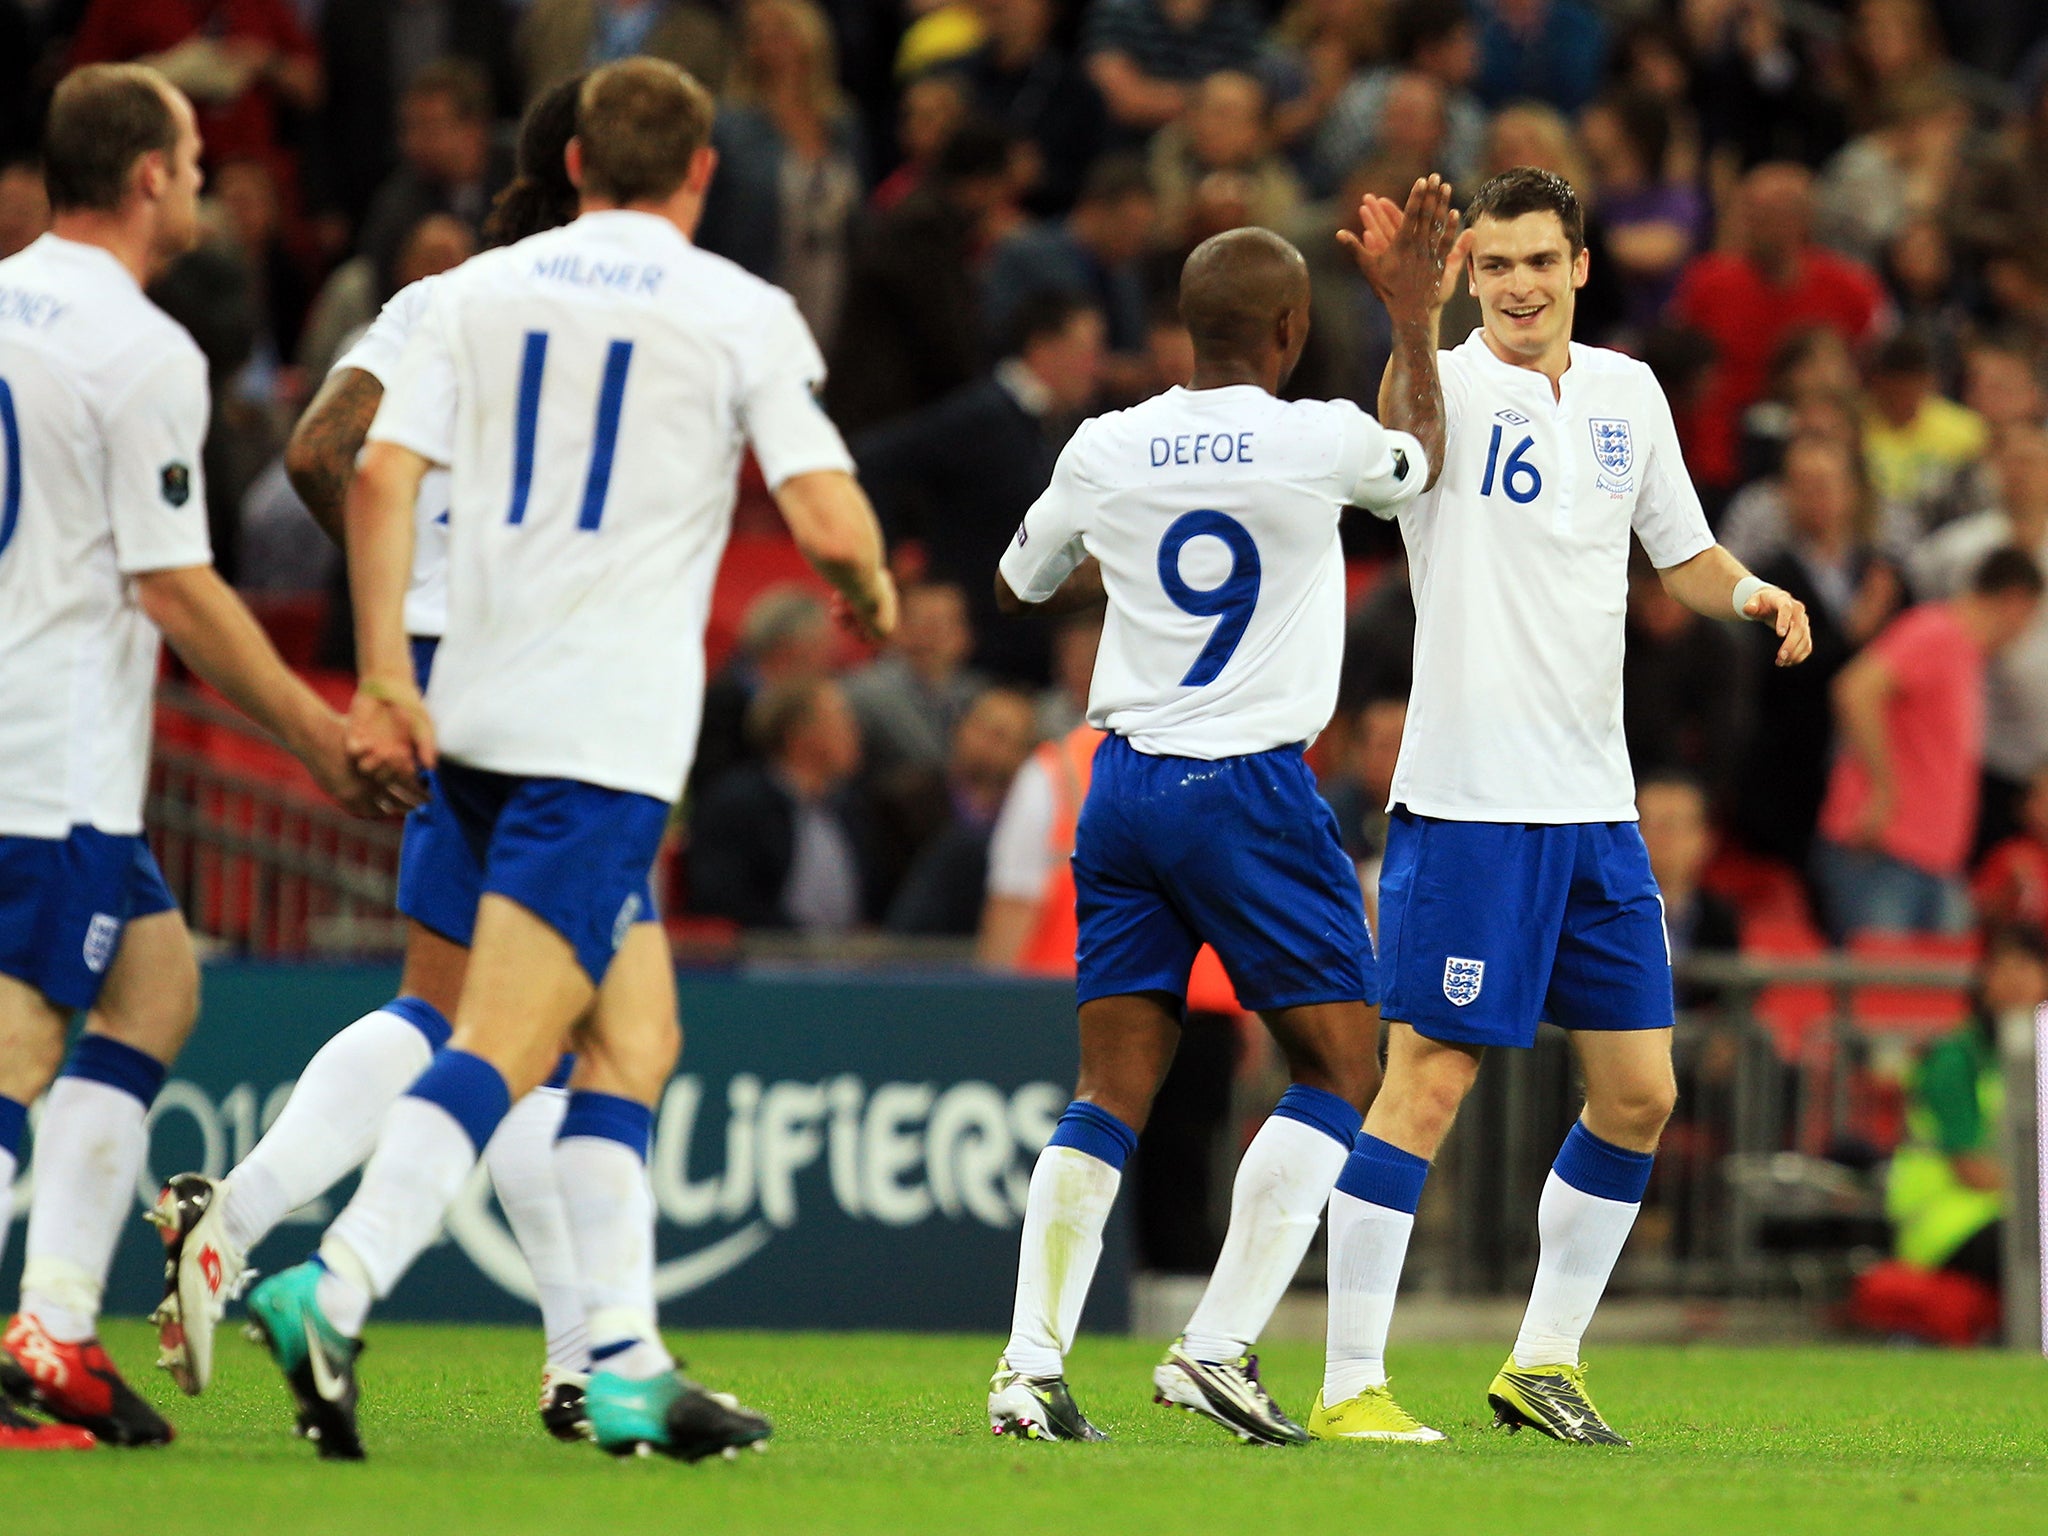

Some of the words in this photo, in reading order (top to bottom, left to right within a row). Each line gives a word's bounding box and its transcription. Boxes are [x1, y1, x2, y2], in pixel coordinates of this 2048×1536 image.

[530, 255, 667, 295] MILNER
[505, 328, 635, 531] 11
[1150, 432, 1254, 467] DEFOE
[1480, 424, 1542, 504] 16
[1157, 508, 1262, 687] 9
